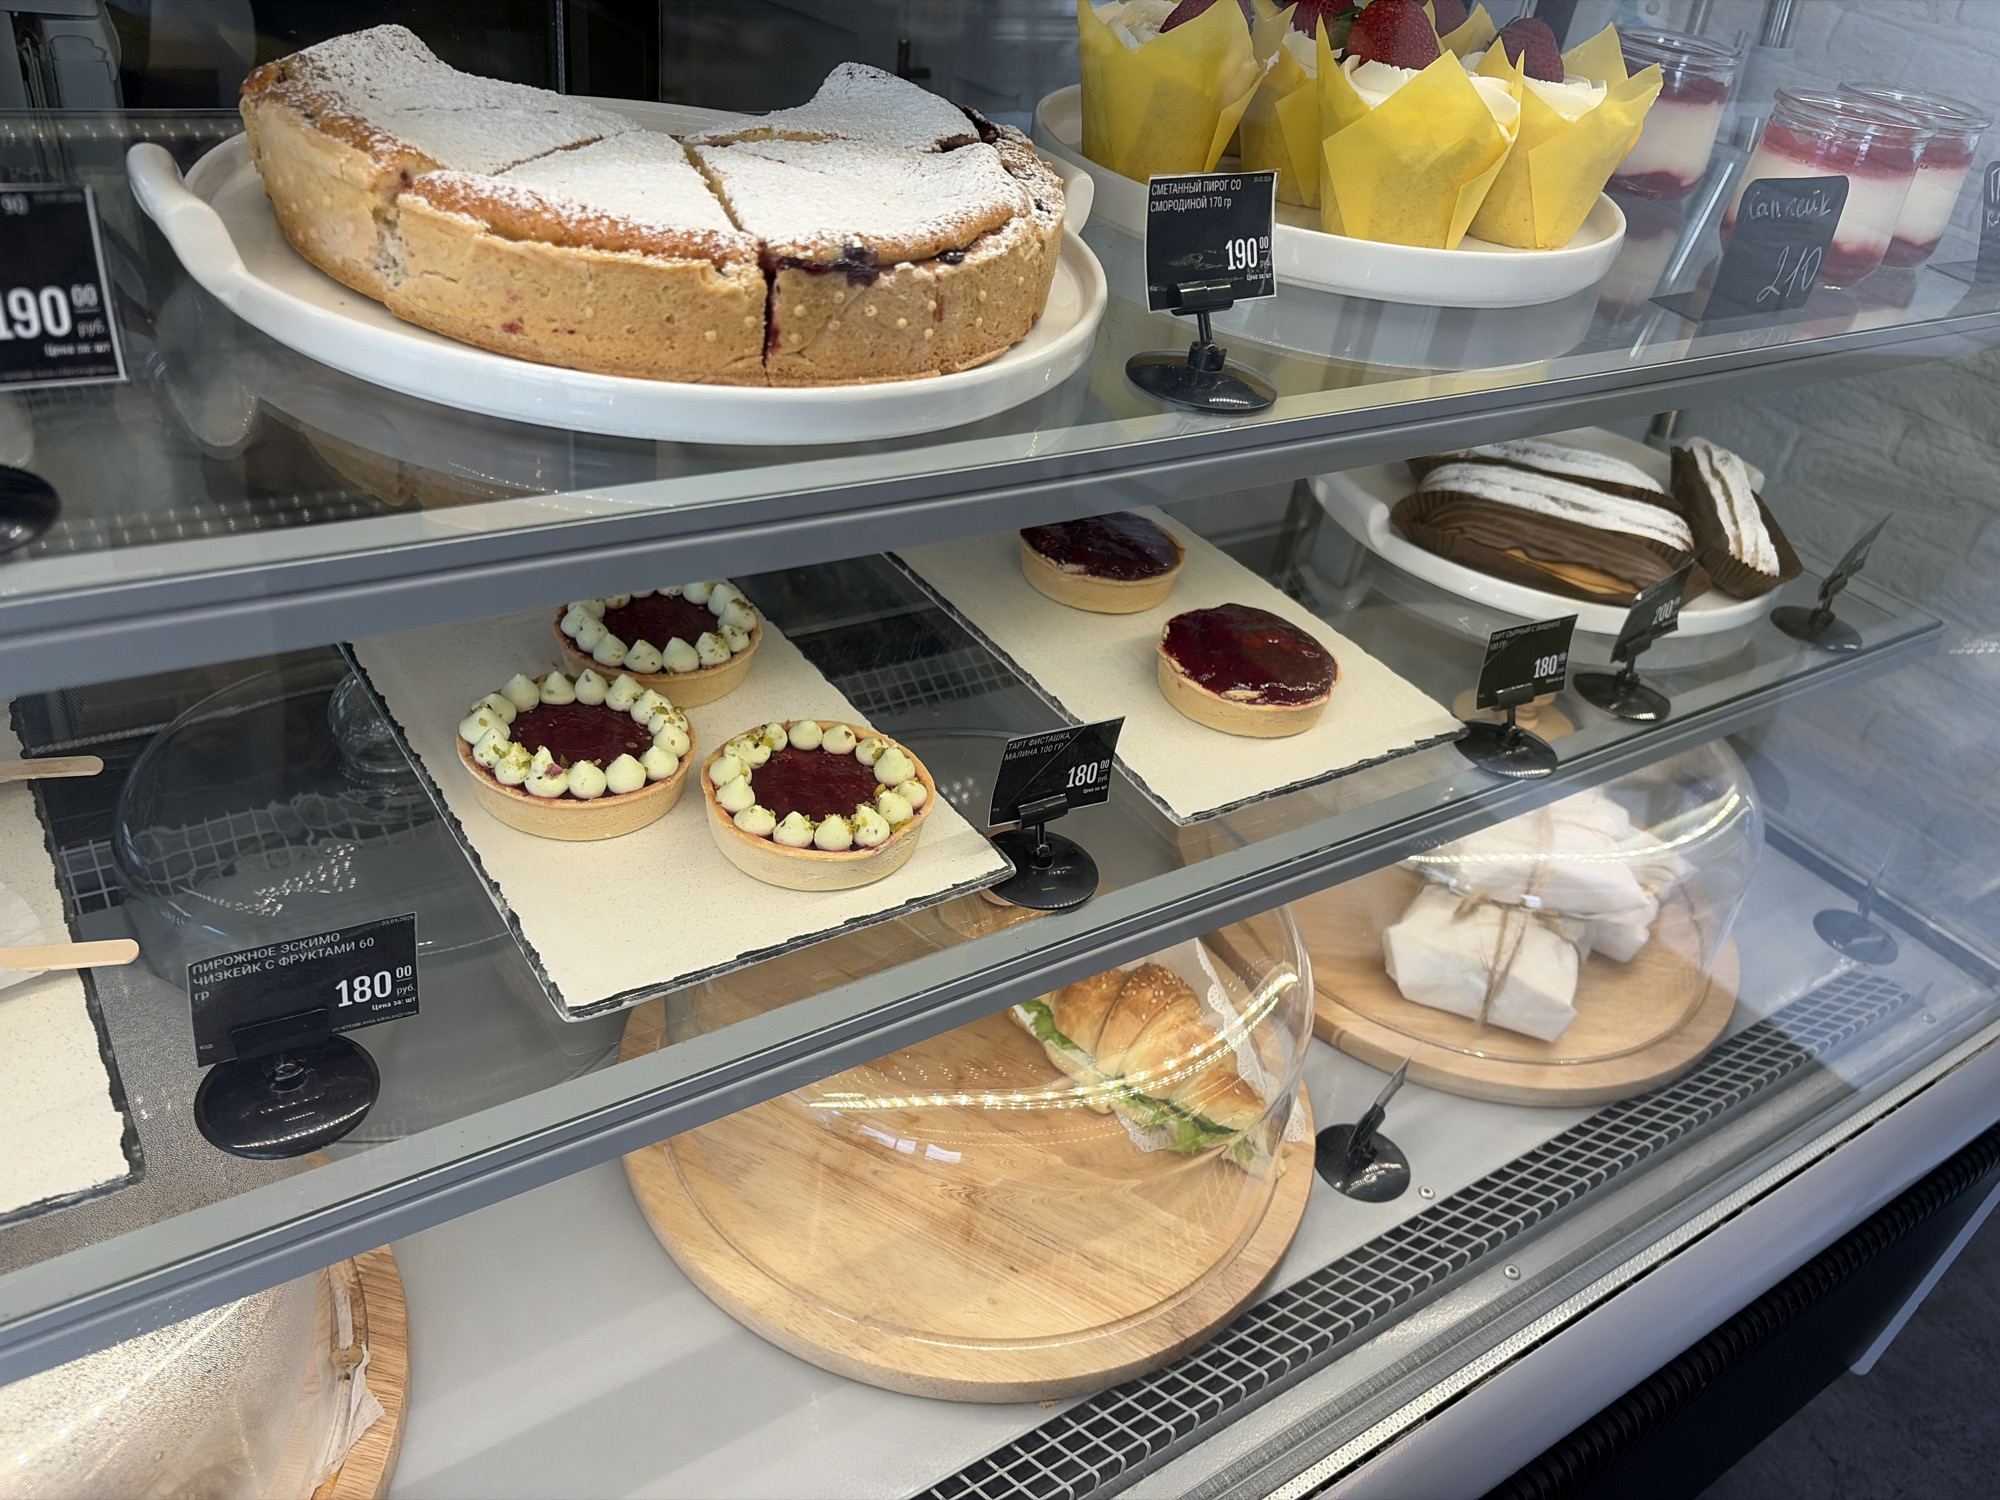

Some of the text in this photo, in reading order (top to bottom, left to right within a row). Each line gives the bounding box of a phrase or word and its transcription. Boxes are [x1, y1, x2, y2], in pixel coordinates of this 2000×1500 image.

[1151, 180, 1202, 196] СМЕТАННЫЙ
[1203, 180, 1228, 192] ПИРОГ
[1230, 179, 1242, 191] СО
[1150, 196, 1232, 213] СМОРОДИНОЙ 170 гр
[1225, 236, 1269, 271] 190 00
[1756, 246, 1823, 303] 210
[0, 283, 98, 340] 190 00
[1652, 599, 1674, 626] 200
[1533, 654, 1558, 679] 180
[1004, 742, 1064, 761] МАЛИНА 100 ГР
[1008, 740, 1028, 751] ТАРТ
[1066, 759, 1110, 788] 180 00
[192, 933, 340, 975] ПИРОЖНОЕ ЭСКИМО
[193, 937, 375, 986] ЧИЗКЕЙК С ФРУКТАМИ 60
[194, 991, 210, 1001] гр
[335, 965, 412, 1008] 180 00
[396, 983, 416, 996] руб.
[372, 1002, 392, 1011] Цена
